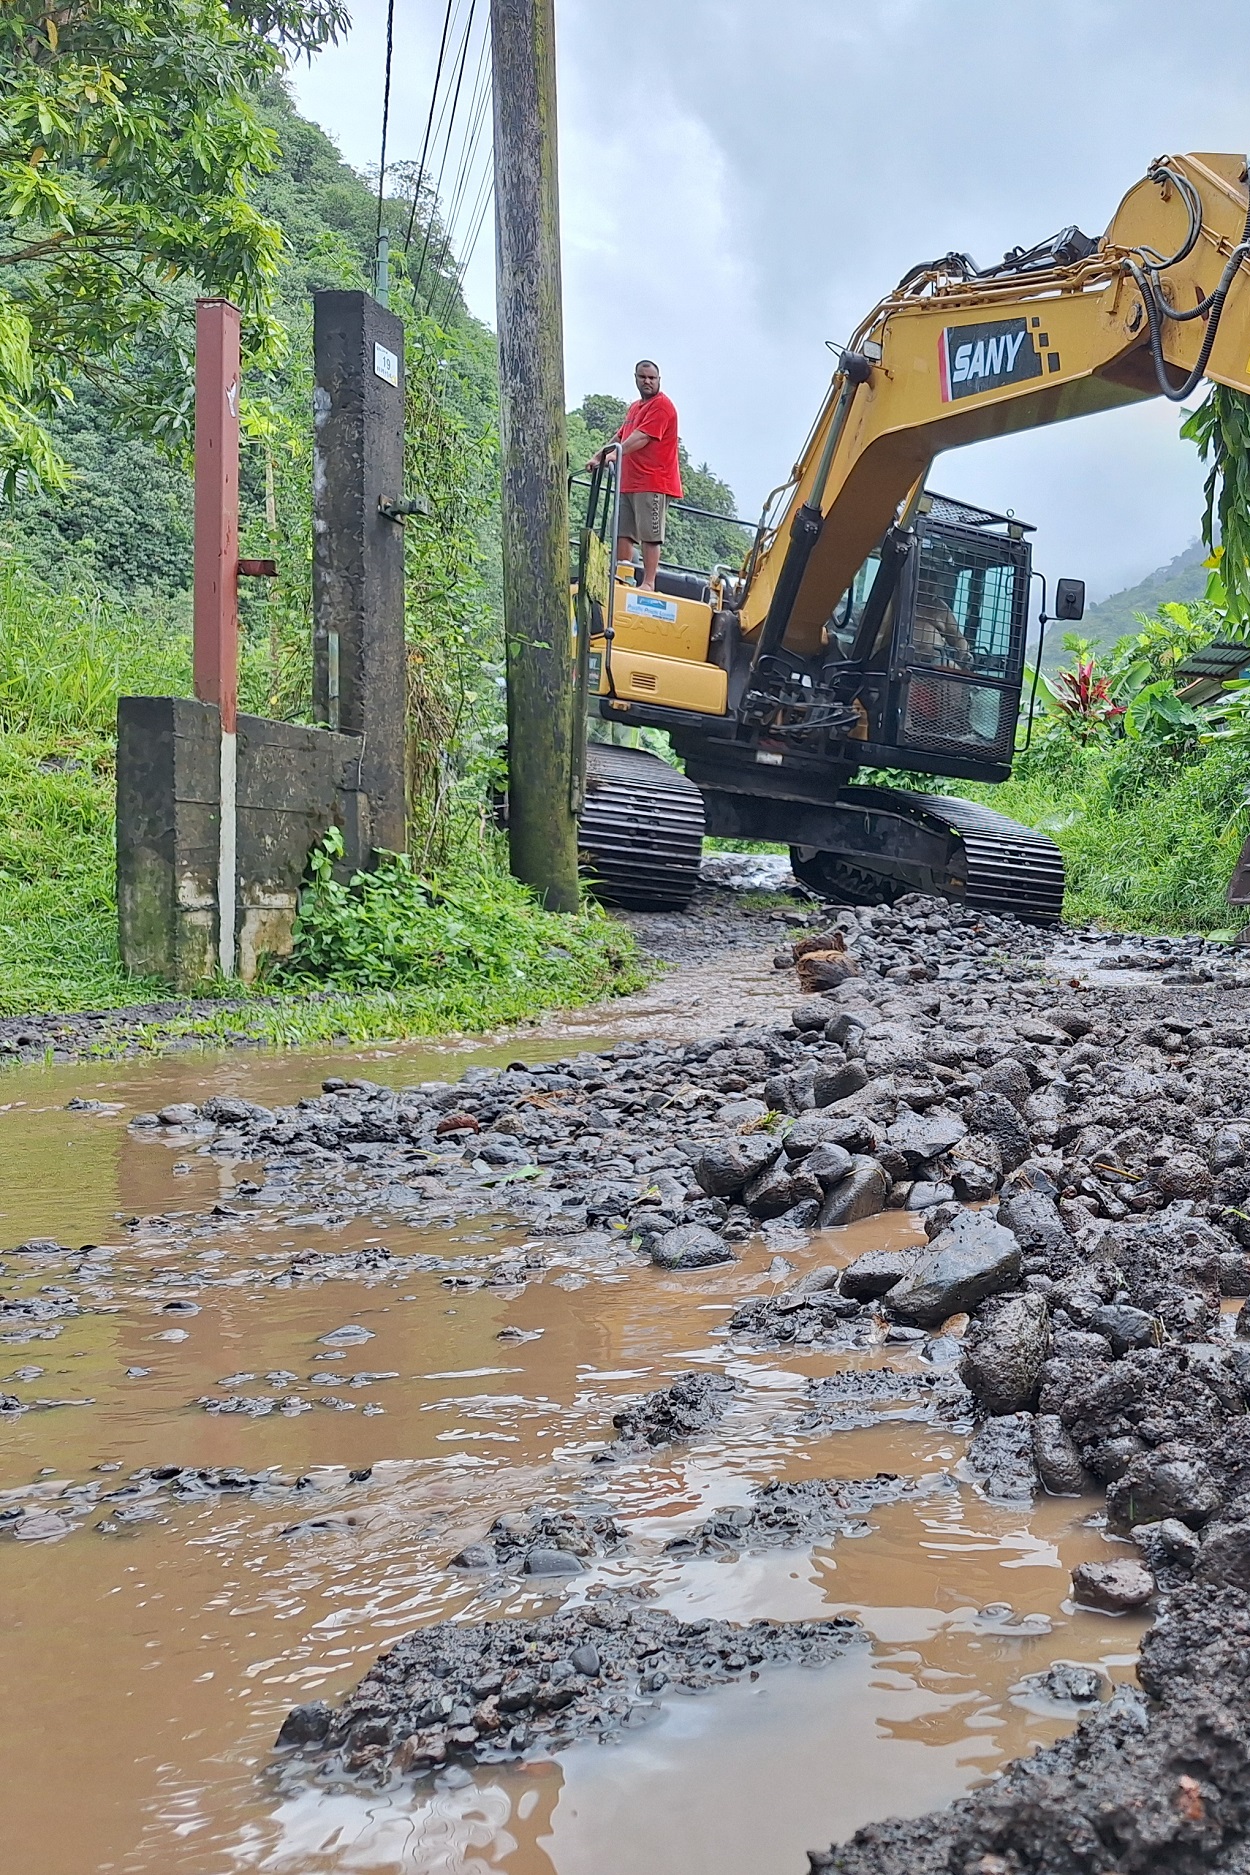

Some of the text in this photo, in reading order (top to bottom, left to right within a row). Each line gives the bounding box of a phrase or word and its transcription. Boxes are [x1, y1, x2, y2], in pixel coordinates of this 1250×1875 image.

[382, 355, 391, 371] 19
[952, 330, 1025, 383] SANY
[614, 610, 689, 639] SANY
